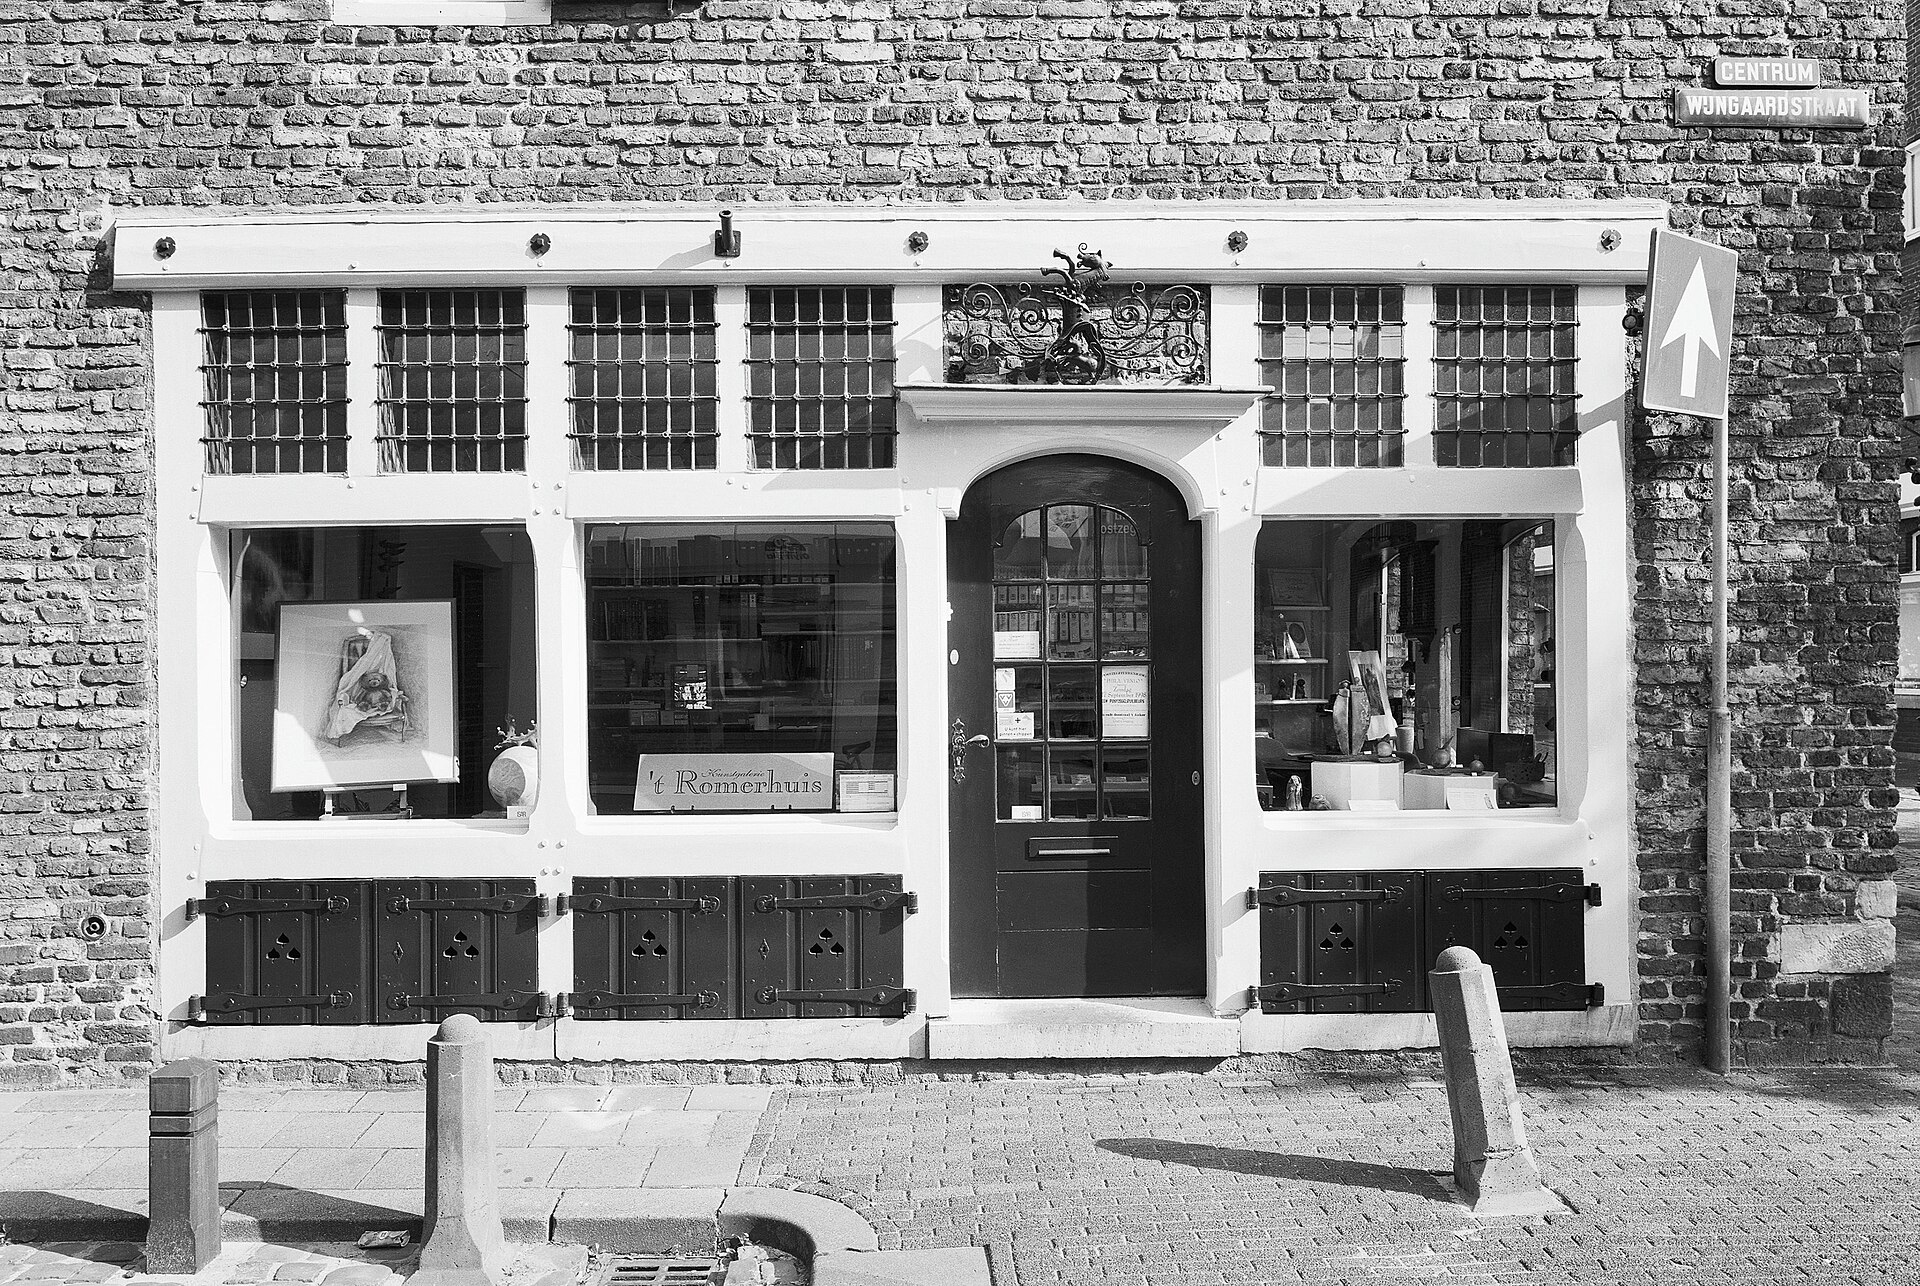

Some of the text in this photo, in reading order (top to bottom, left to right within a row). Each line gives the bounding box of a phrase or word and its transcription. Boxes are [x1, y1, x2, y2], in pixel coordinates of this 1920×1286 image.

[1721, 62, 1813, 82] CENTRUM
[648, 770, 666, 795] 't
[673, 769, 823, 795] Romerhuis
[701, 768, 765, 779] Kunstgalerie
